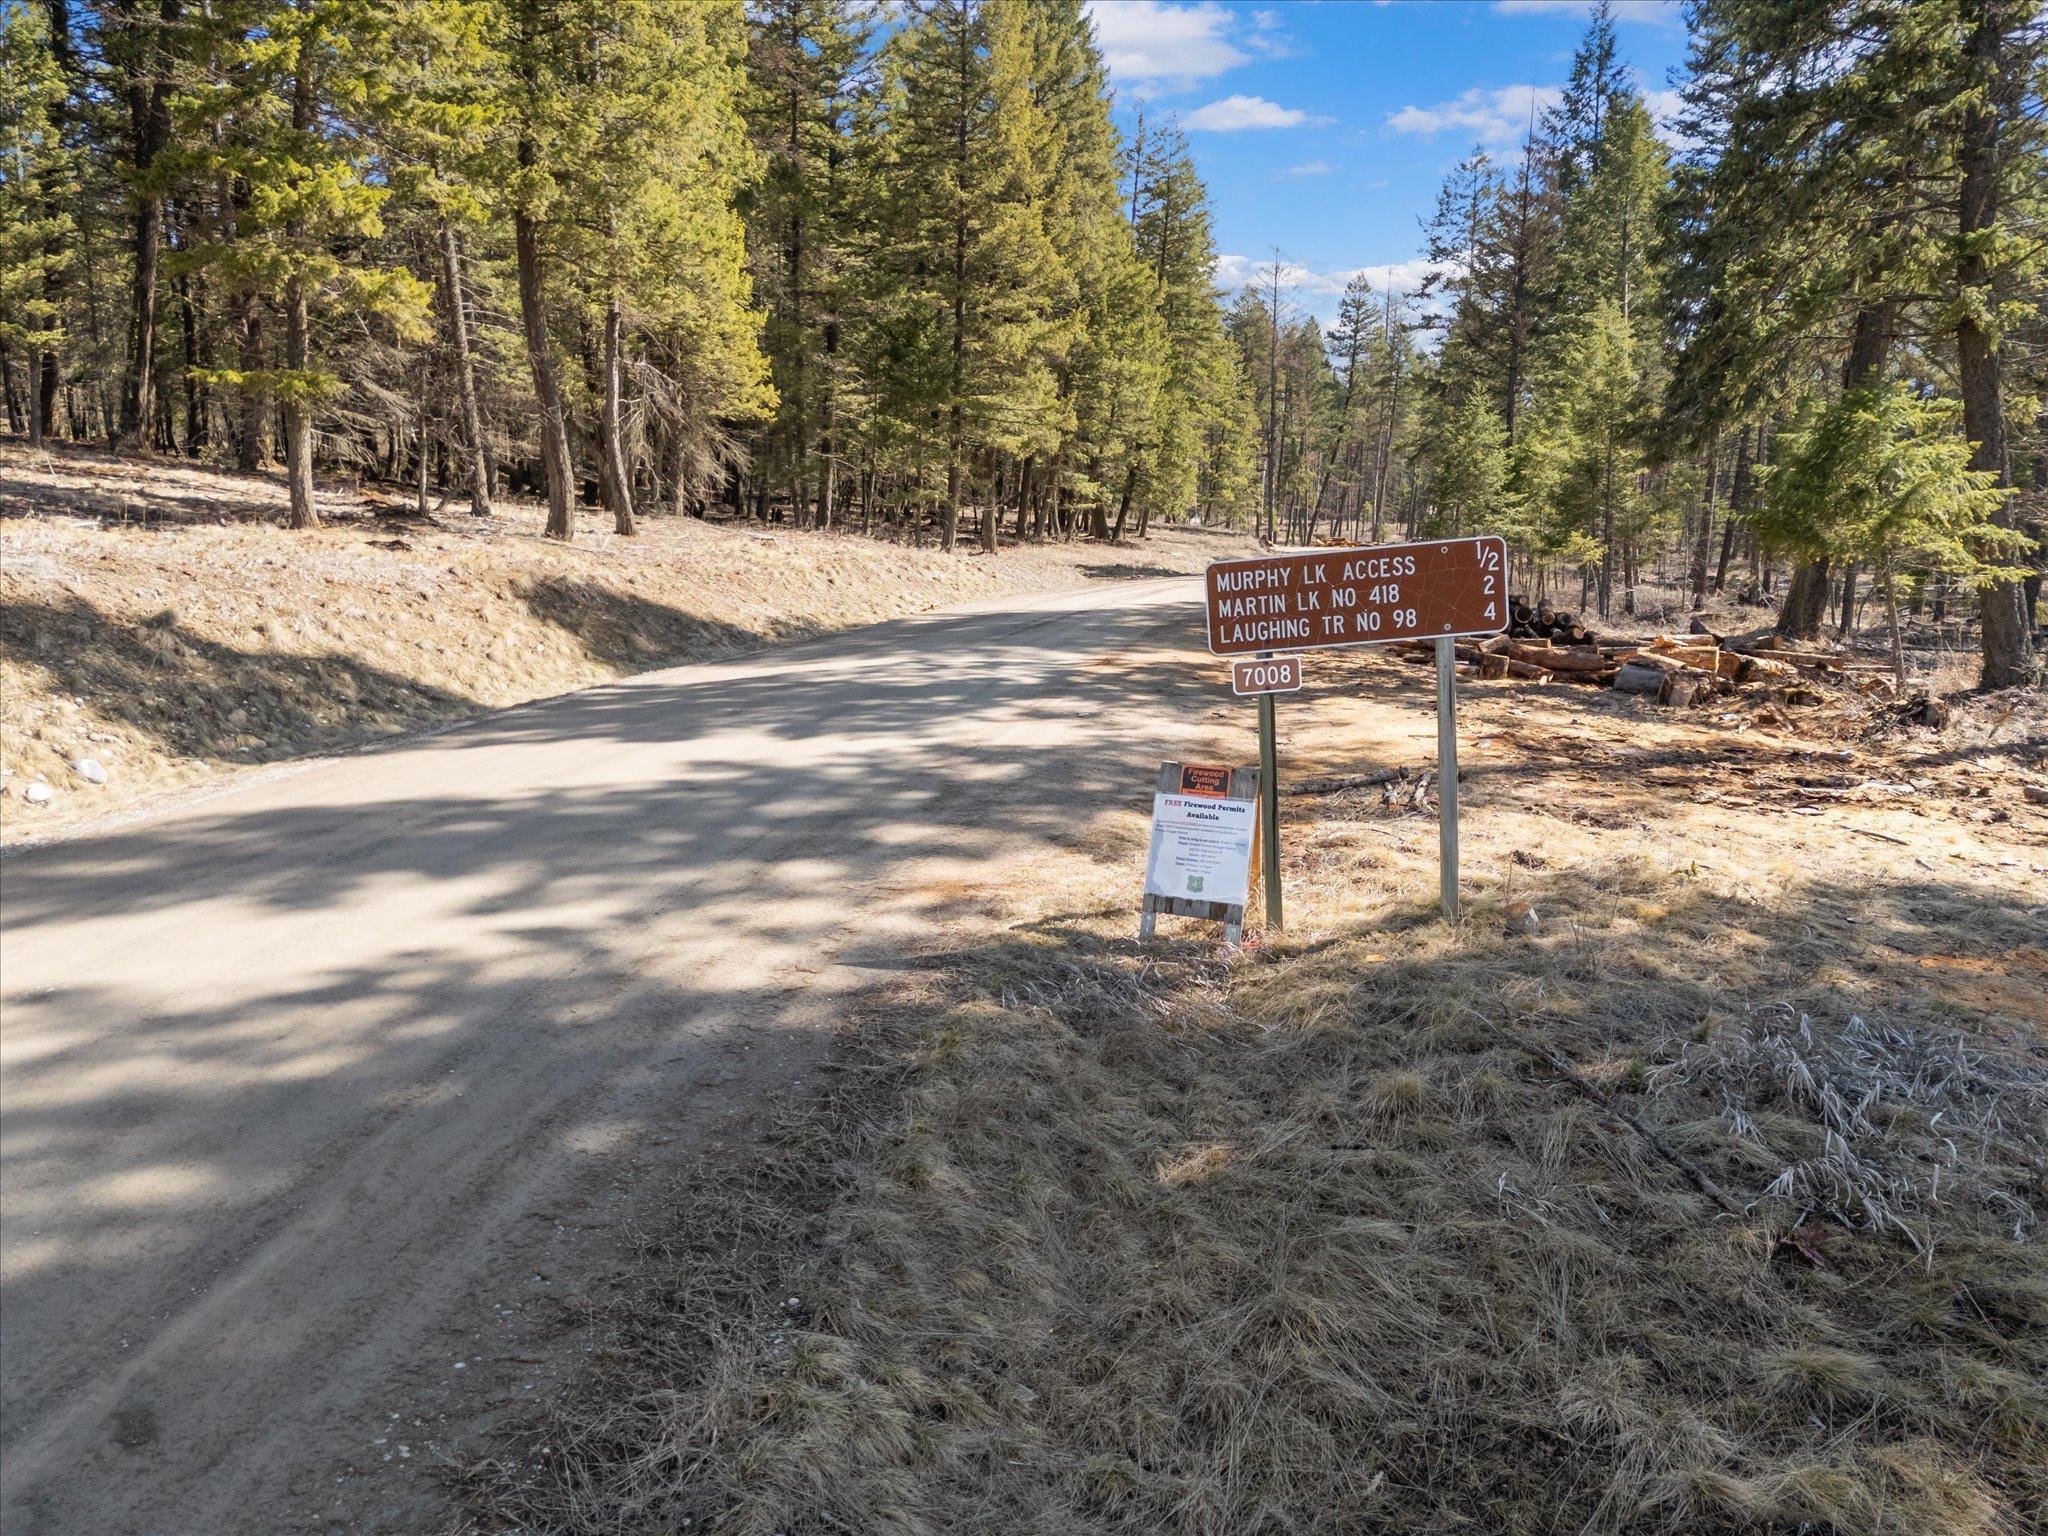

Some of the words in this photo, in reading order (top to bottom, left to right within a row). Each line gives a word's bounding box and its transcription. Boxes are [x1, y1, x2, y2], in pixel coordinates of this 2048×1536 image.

[1216, 567, 1292, 593] MURPHY
[1303, 564, 1327, 585] LK
[1343, 555, 1416, 581] ACCESS
[1218, 594, 1286, 618] MARTIN
[1297, 590, 1320, 611] LK
[1332, 587, 1357, 608] NO
[1368, 583, 1400, 605] 418
[1483, 575, 1496, 595] 2
[1219, 618, 1310, 644] LAUGHING
[1322, 615, 1345, 636] TR
[1356, 611, 1381, 632] NO
[1392, 608, 1417, 629] 98
[1483, 601, 1497, 621] 4
[1242, 664, 1292, 687] 7008
[1188, 768, 1224, 778] Firewood
[1190, 775, 1220, 786] Cutting
[1195, 783, 1214, 791] Area
[1164, 799, 1182, 807] FREE
[1183, 801, 1216, 811] Firewood
[1218, 804, 1246, 814] Permits
[1186, 811, 1219, 821] Available
